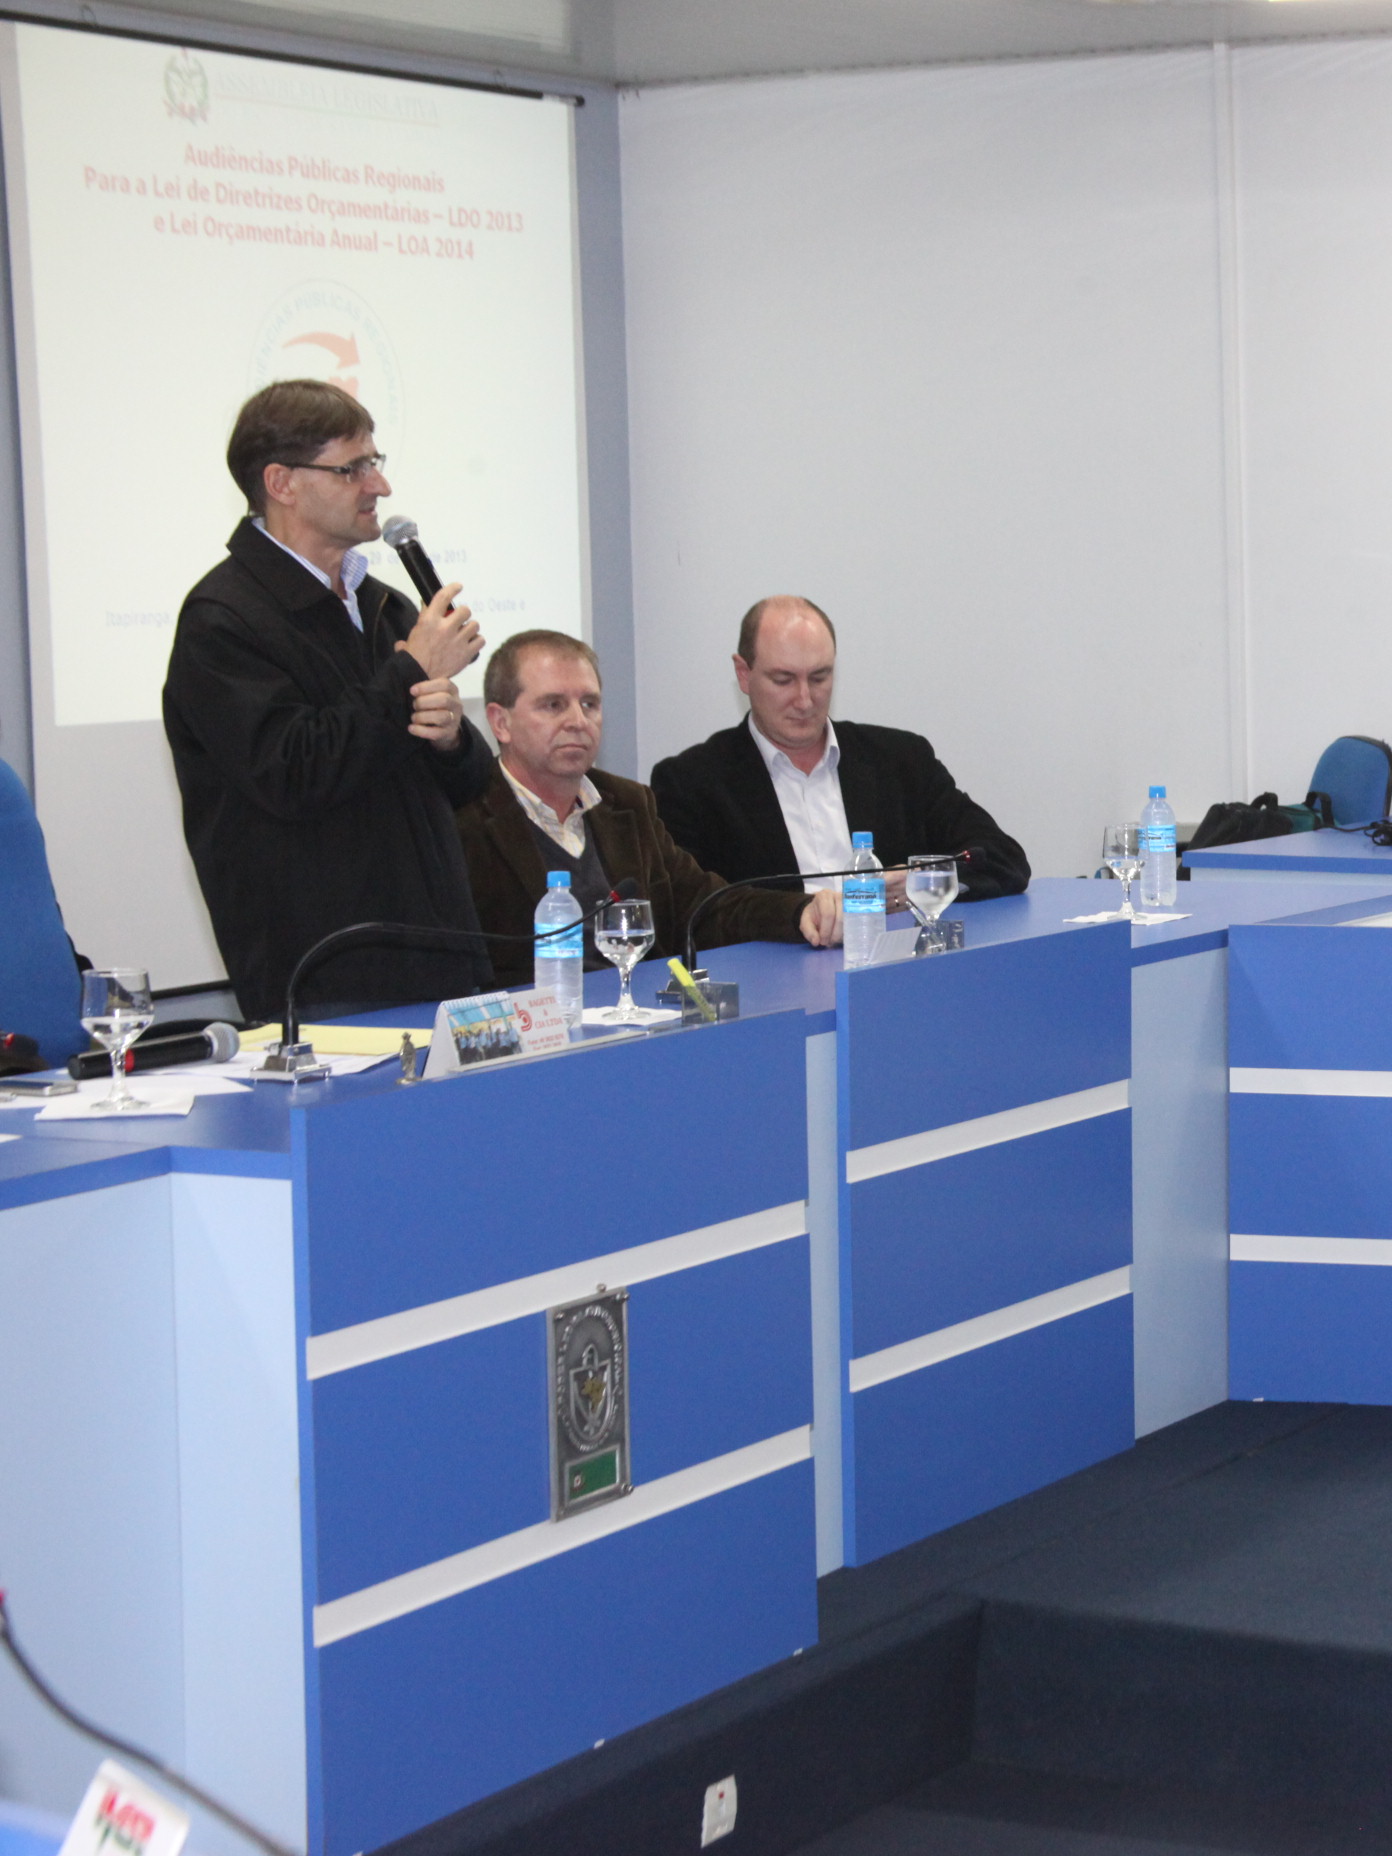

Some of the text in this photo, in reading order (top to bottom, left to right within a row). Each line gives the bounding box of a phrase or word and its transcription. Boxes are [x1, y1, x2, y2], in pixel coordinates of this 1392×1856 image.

[184, 142, 446, 194] Audiências Públicas Regionais
[83, 164, 131, 194] Para
[136, 177, 148, 196] a
[153, 173, 181, 200] Lei
[187, 177, 211, 203] de
[214, 180, 303, 213] Diretrizes
[307, 192, 430, 225] Orçamentárias
[447, 205, 481, 229] LDO
[486, 209, 524, 233] 2013
[153, 214, 165, 233] e
[170, 210, 198, 237] Lei
[203, 215, 326, 248] Orçamentária
[330, 227, 379, 253] Anual
[397, 232, 431, 256] LOA
[435, 236, 475, 260] 2014
